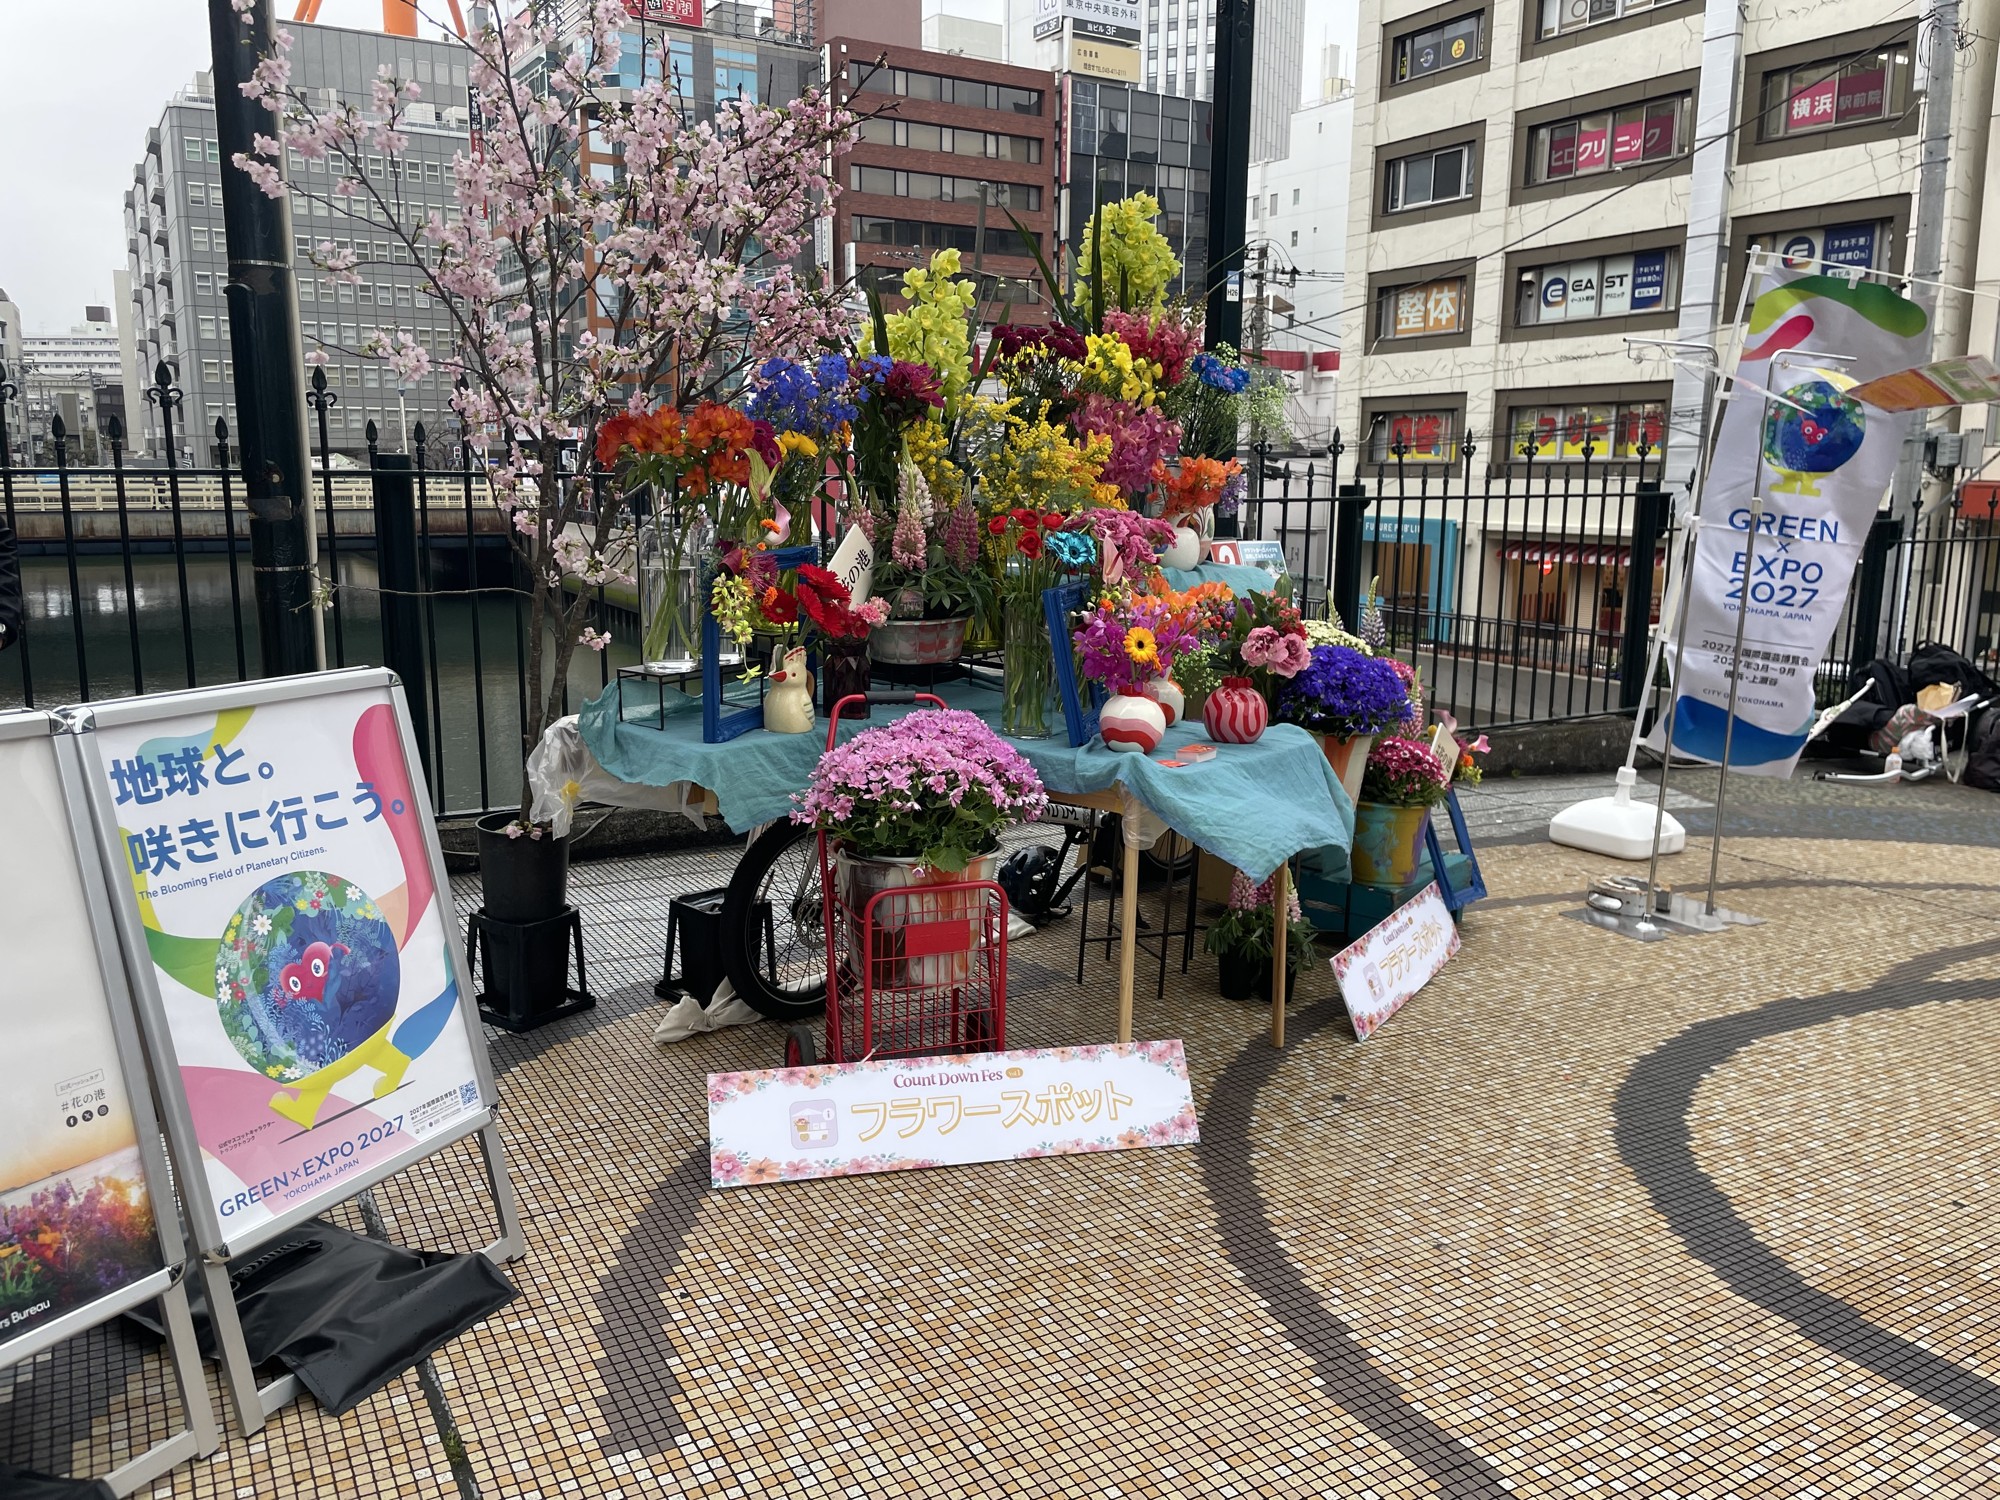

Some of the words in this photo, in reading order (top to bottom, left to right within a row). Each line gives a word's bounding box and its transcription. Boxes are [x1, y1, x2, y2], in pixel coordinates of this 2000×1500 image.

[1105, 26, 1117, 36] 3F
[1397, 284, 1457, 330] 整体
[1365, 522, 1392, 532] FUURE
[1728, 508, 1839, 543] GREEN
[1731, 551, 1823, 584] EXPO
[1725, 576, 1819, 609] 2027
[1783, 610, 1812, 622] JAPAN
[1703, 688, 1721, 697] CITY
[109, 743, 274, 806] 地球と。
[126, 782, 405, 877] 咲きに行こう。
[139, 888, 159, 901] The
[160, 876, 209, 896] Blooming
[209, 869, 234, 884] Field
[235, 864, 244, 876] of
[245, 855, 289, 875] Planetary
[290, 846, 328, 862] Citizens.
[893, 1073, 937, 1088] Count
[938, 1071, 979, 1086] Down
[981, 1069, 1003, 1082] Fes
[850, 1080, 1133, 1143] フラワースポット
[219, 1171, 288, 1217] GREEN
[303, 1141, 355, 1177] EXPO
[357, 1115, 404, 1150] 2027
[283, 1172, 332, 1200] YOKOHAMA
[334, 1158, 360, 1176] JAPAN
[11, 1299, 51, 1323] Bureau
